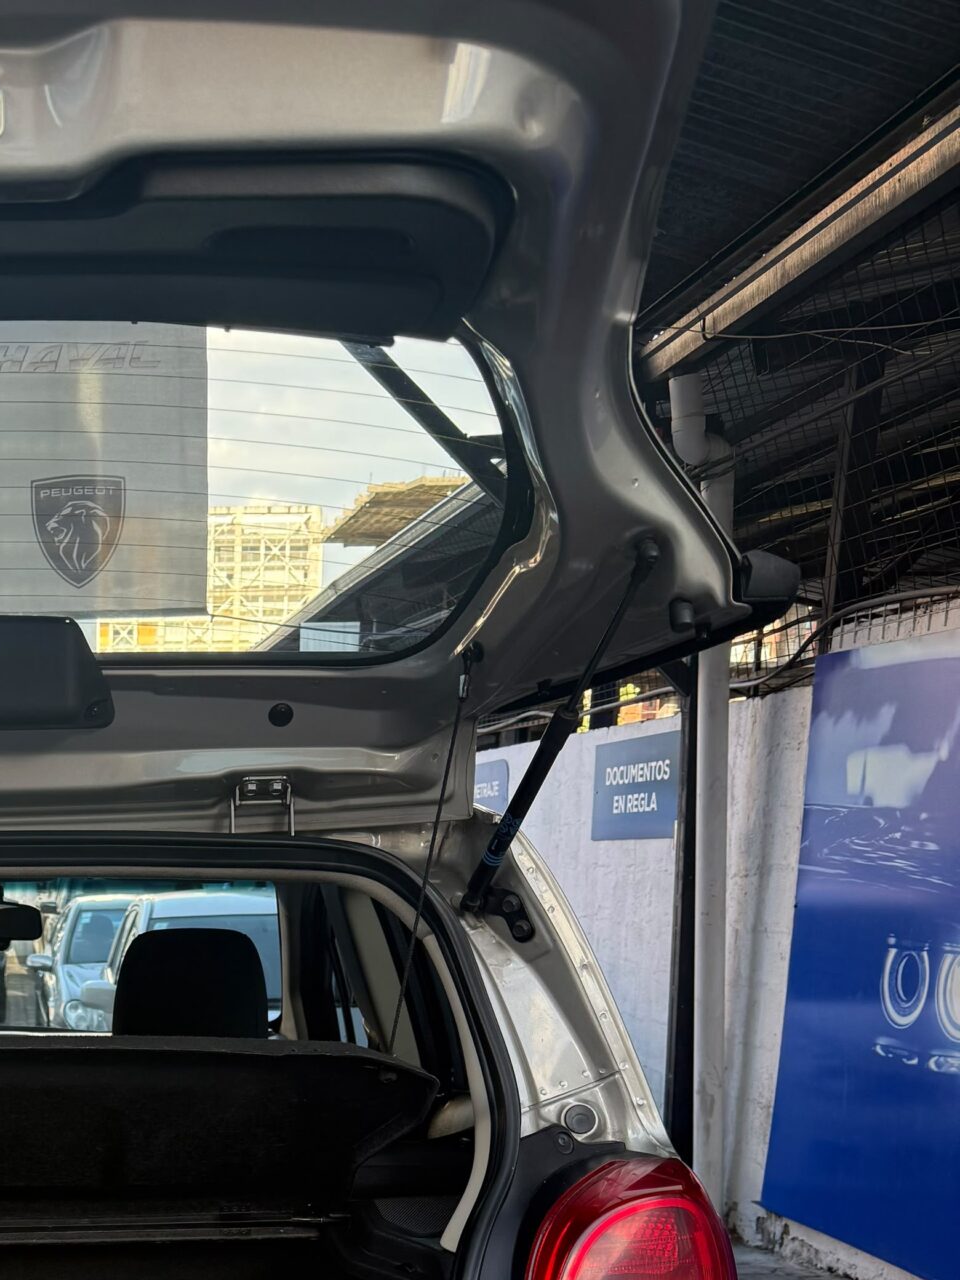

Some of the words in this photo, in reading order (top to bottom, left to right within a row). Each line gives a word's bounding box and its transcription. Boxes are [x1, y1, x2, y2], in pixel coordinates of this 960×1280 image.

[40, 486, 115, 498] PEUGEOT
[605, 759, 671, 786] DOCUMENTOS
[613, 795, 626, 814] EN
[626, 792, 658, 813] REGLA
